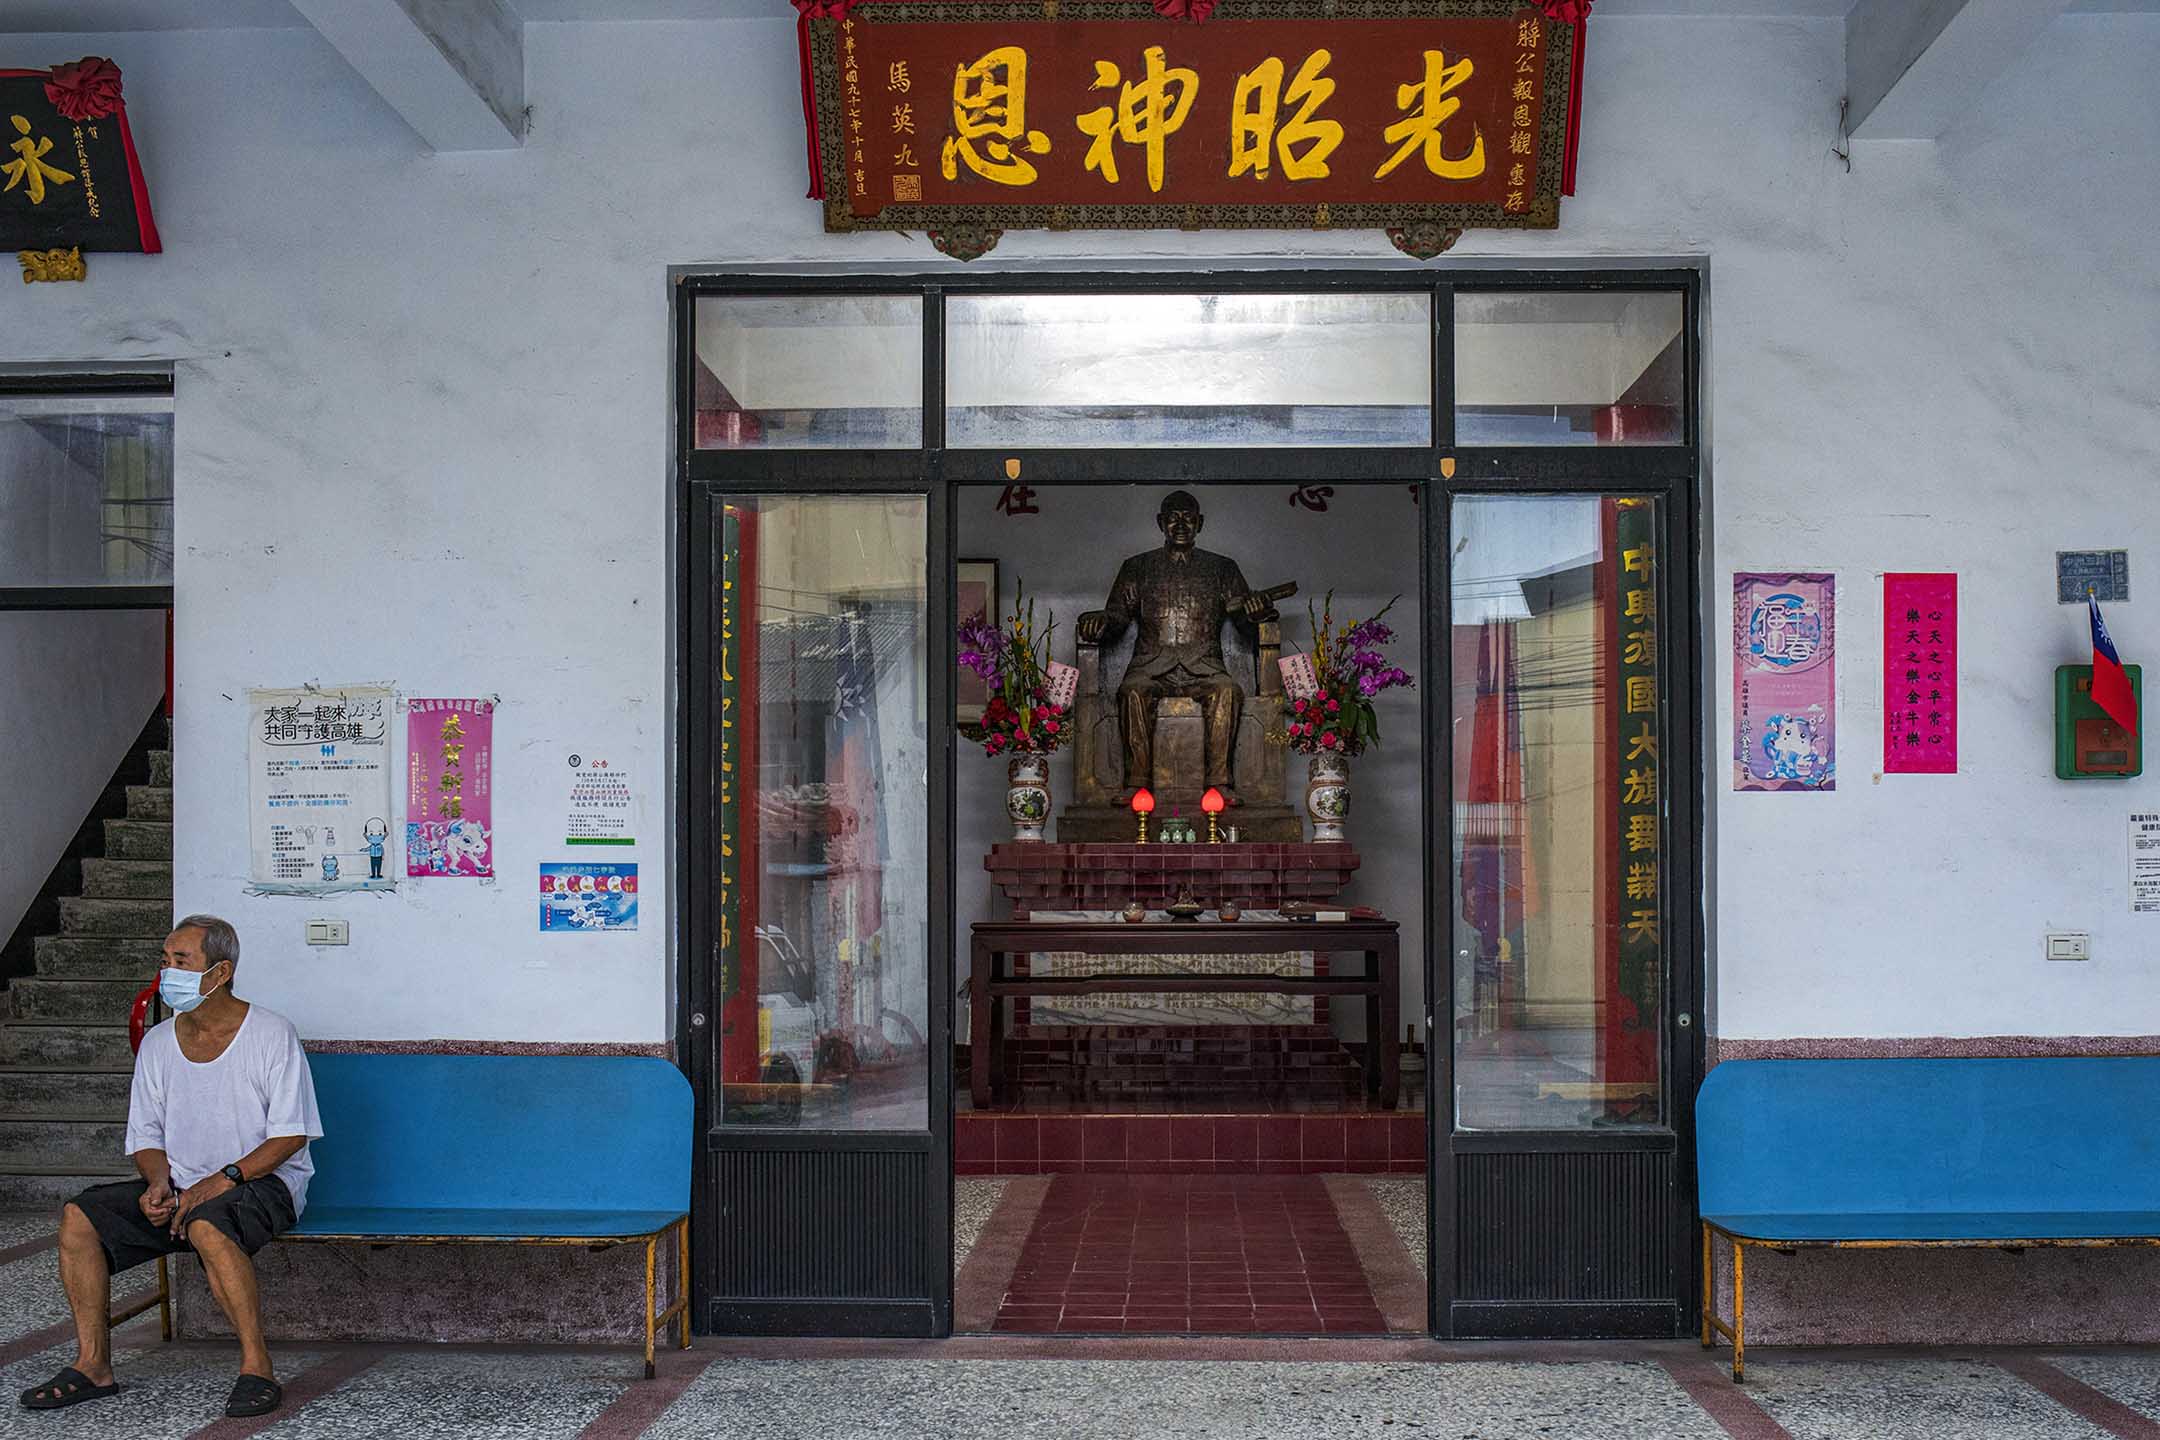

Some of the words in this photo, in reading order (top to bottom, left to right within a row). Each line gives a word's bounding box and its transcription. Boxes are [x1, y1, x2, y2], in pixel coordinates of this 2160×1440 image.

[888, 61, 919, 167] 馬英九
[1, 114, 76, 205] 永
[264, 705, 347, 724] 大家一起來
[264, 723, 363, 740] 共同守護高雄
